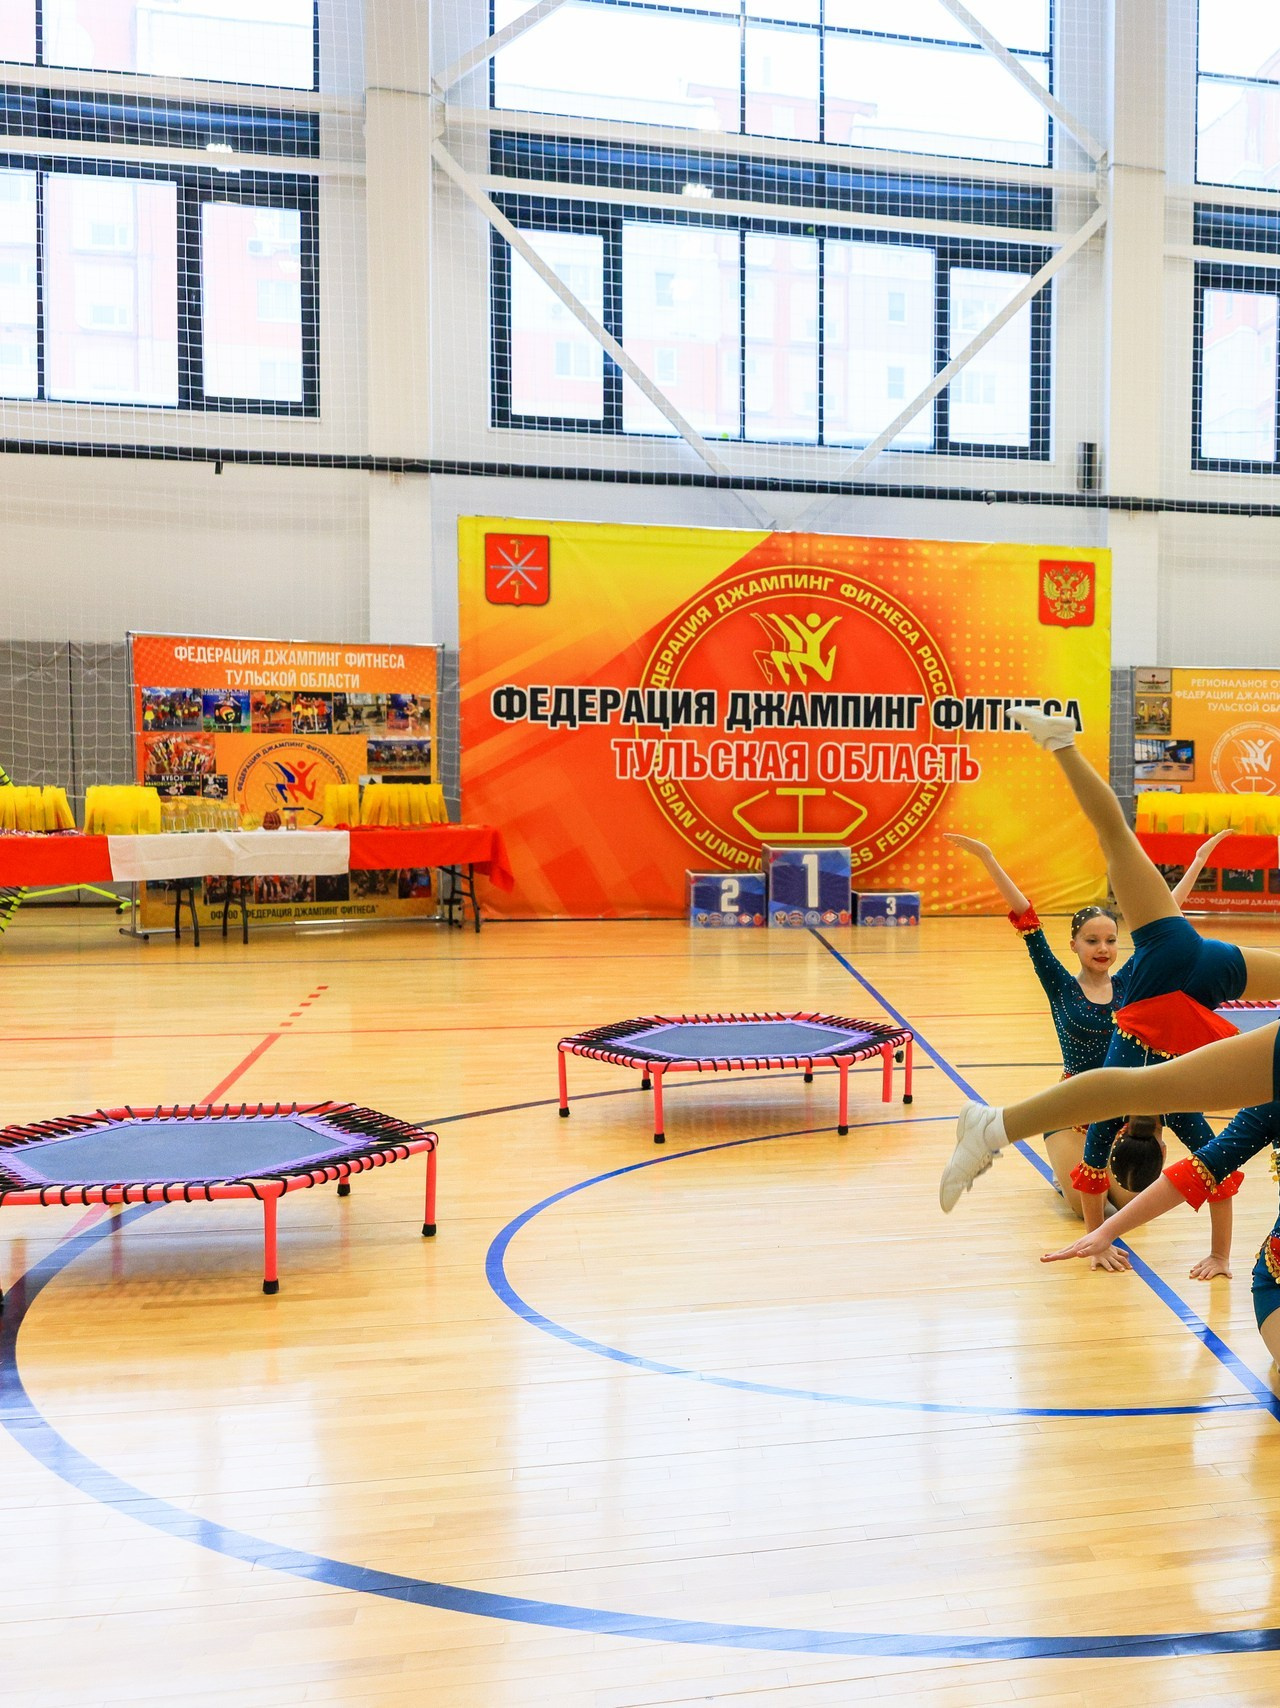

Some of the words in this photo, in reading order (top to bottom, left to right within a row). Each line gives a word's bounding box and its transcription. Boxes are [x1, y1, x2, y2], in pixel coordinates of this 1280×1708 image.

[650, 605, 713, 689] ДЕРАЦИЯ
[714, 574, 834, 613] ДЖАМПИНГ
[839, 583, 920, 646] ФИТНЕСА
[916, 644, 948, 698] РОСС
[174, 646, 260, 664] ФЕДЕРАЦИЯ
[263, 649, 341, 667] ДЖАМПИНГ
[345, 653, 405, 669] ФИТНЕСА
[225, 669, 297, 687] ТУЛЬСКОЙ
[300, 673, 360, 688] ОБЛАСТИ
[1191, 678, 1268, 688] РЕГИОНАЛЬНОЕ
[1175, 690, 1234, 700] ФЕДЕРАЦИИ
[492, 685, 716, 730] ФЕДЕРАЦИЯ
[725, 690, 923, 733] ДЖАМПИНГ
[1208, 702, 1259, 712] ТУЛЬСКОЙ
[262, 742, 304, 755] ДЖАМПИНГ
[611, 739, 808, 780] ТУЛЬСКАЯ
[817, 743, 980, 783] ОБЛАСТЬ
[655, 776, 697, 829] SIAN
[876, 776, 942, 852] FEDERAT
[801, 853, 819, 908] 1
[720, 878, 740, 913] 2
[885, 896, 897, 915] 3
[211, 910, 238, 920] ОФОО
[294, 906, 337, 917] ДЖАМПИНГ
